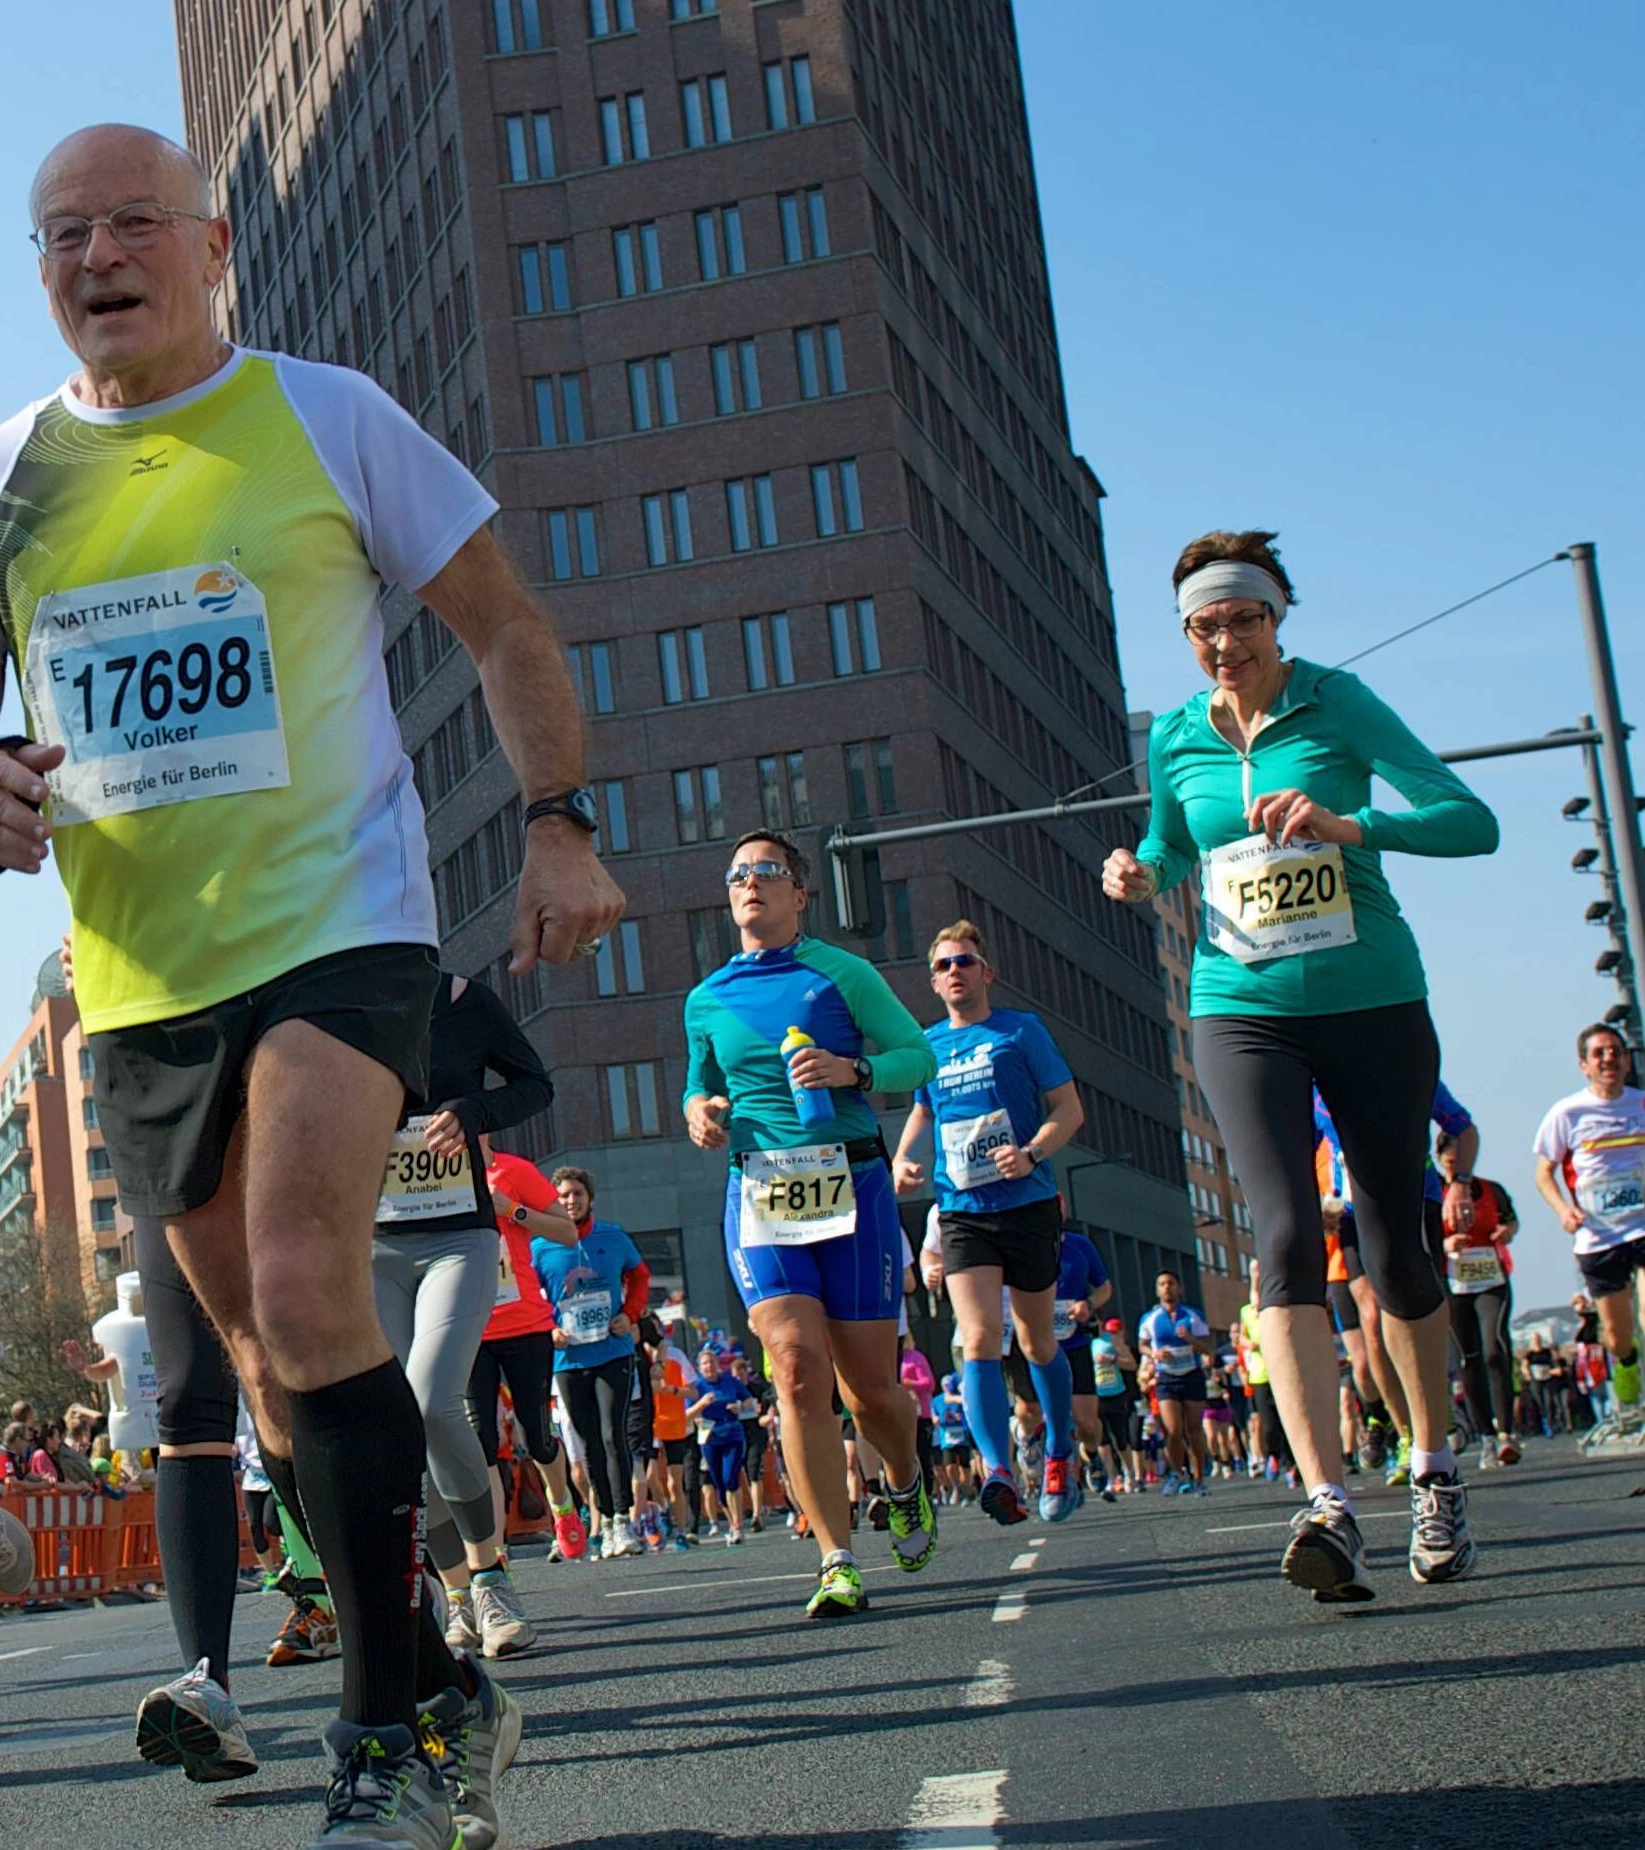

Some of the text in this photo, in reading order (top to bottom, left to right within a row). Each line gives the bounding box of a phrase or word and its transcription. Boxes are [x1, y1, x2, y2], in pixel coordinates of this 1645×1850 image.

[53, 590, 187, 630] VATTENFALL
[50, 658, 67, 683] E
[73, 636, 252, 734] 17698
[123, 725, 199, 751] Volker
[102, 761, 238, 798] Energie für Berlin
[1228, 840, 1297, 863] VATTENFALL
[1238, 864, 1336, 919] F5220
[1257, 910, 1318, 929] Marianne
[1288, 937, 1301, 945] für
[1304, 930, 1332, 942] Berlin
[386, 1151, 463, 1185] F3900
[406, 1182, 442, 1195] Anabel
[768, 1174, 847, 1212] F817
